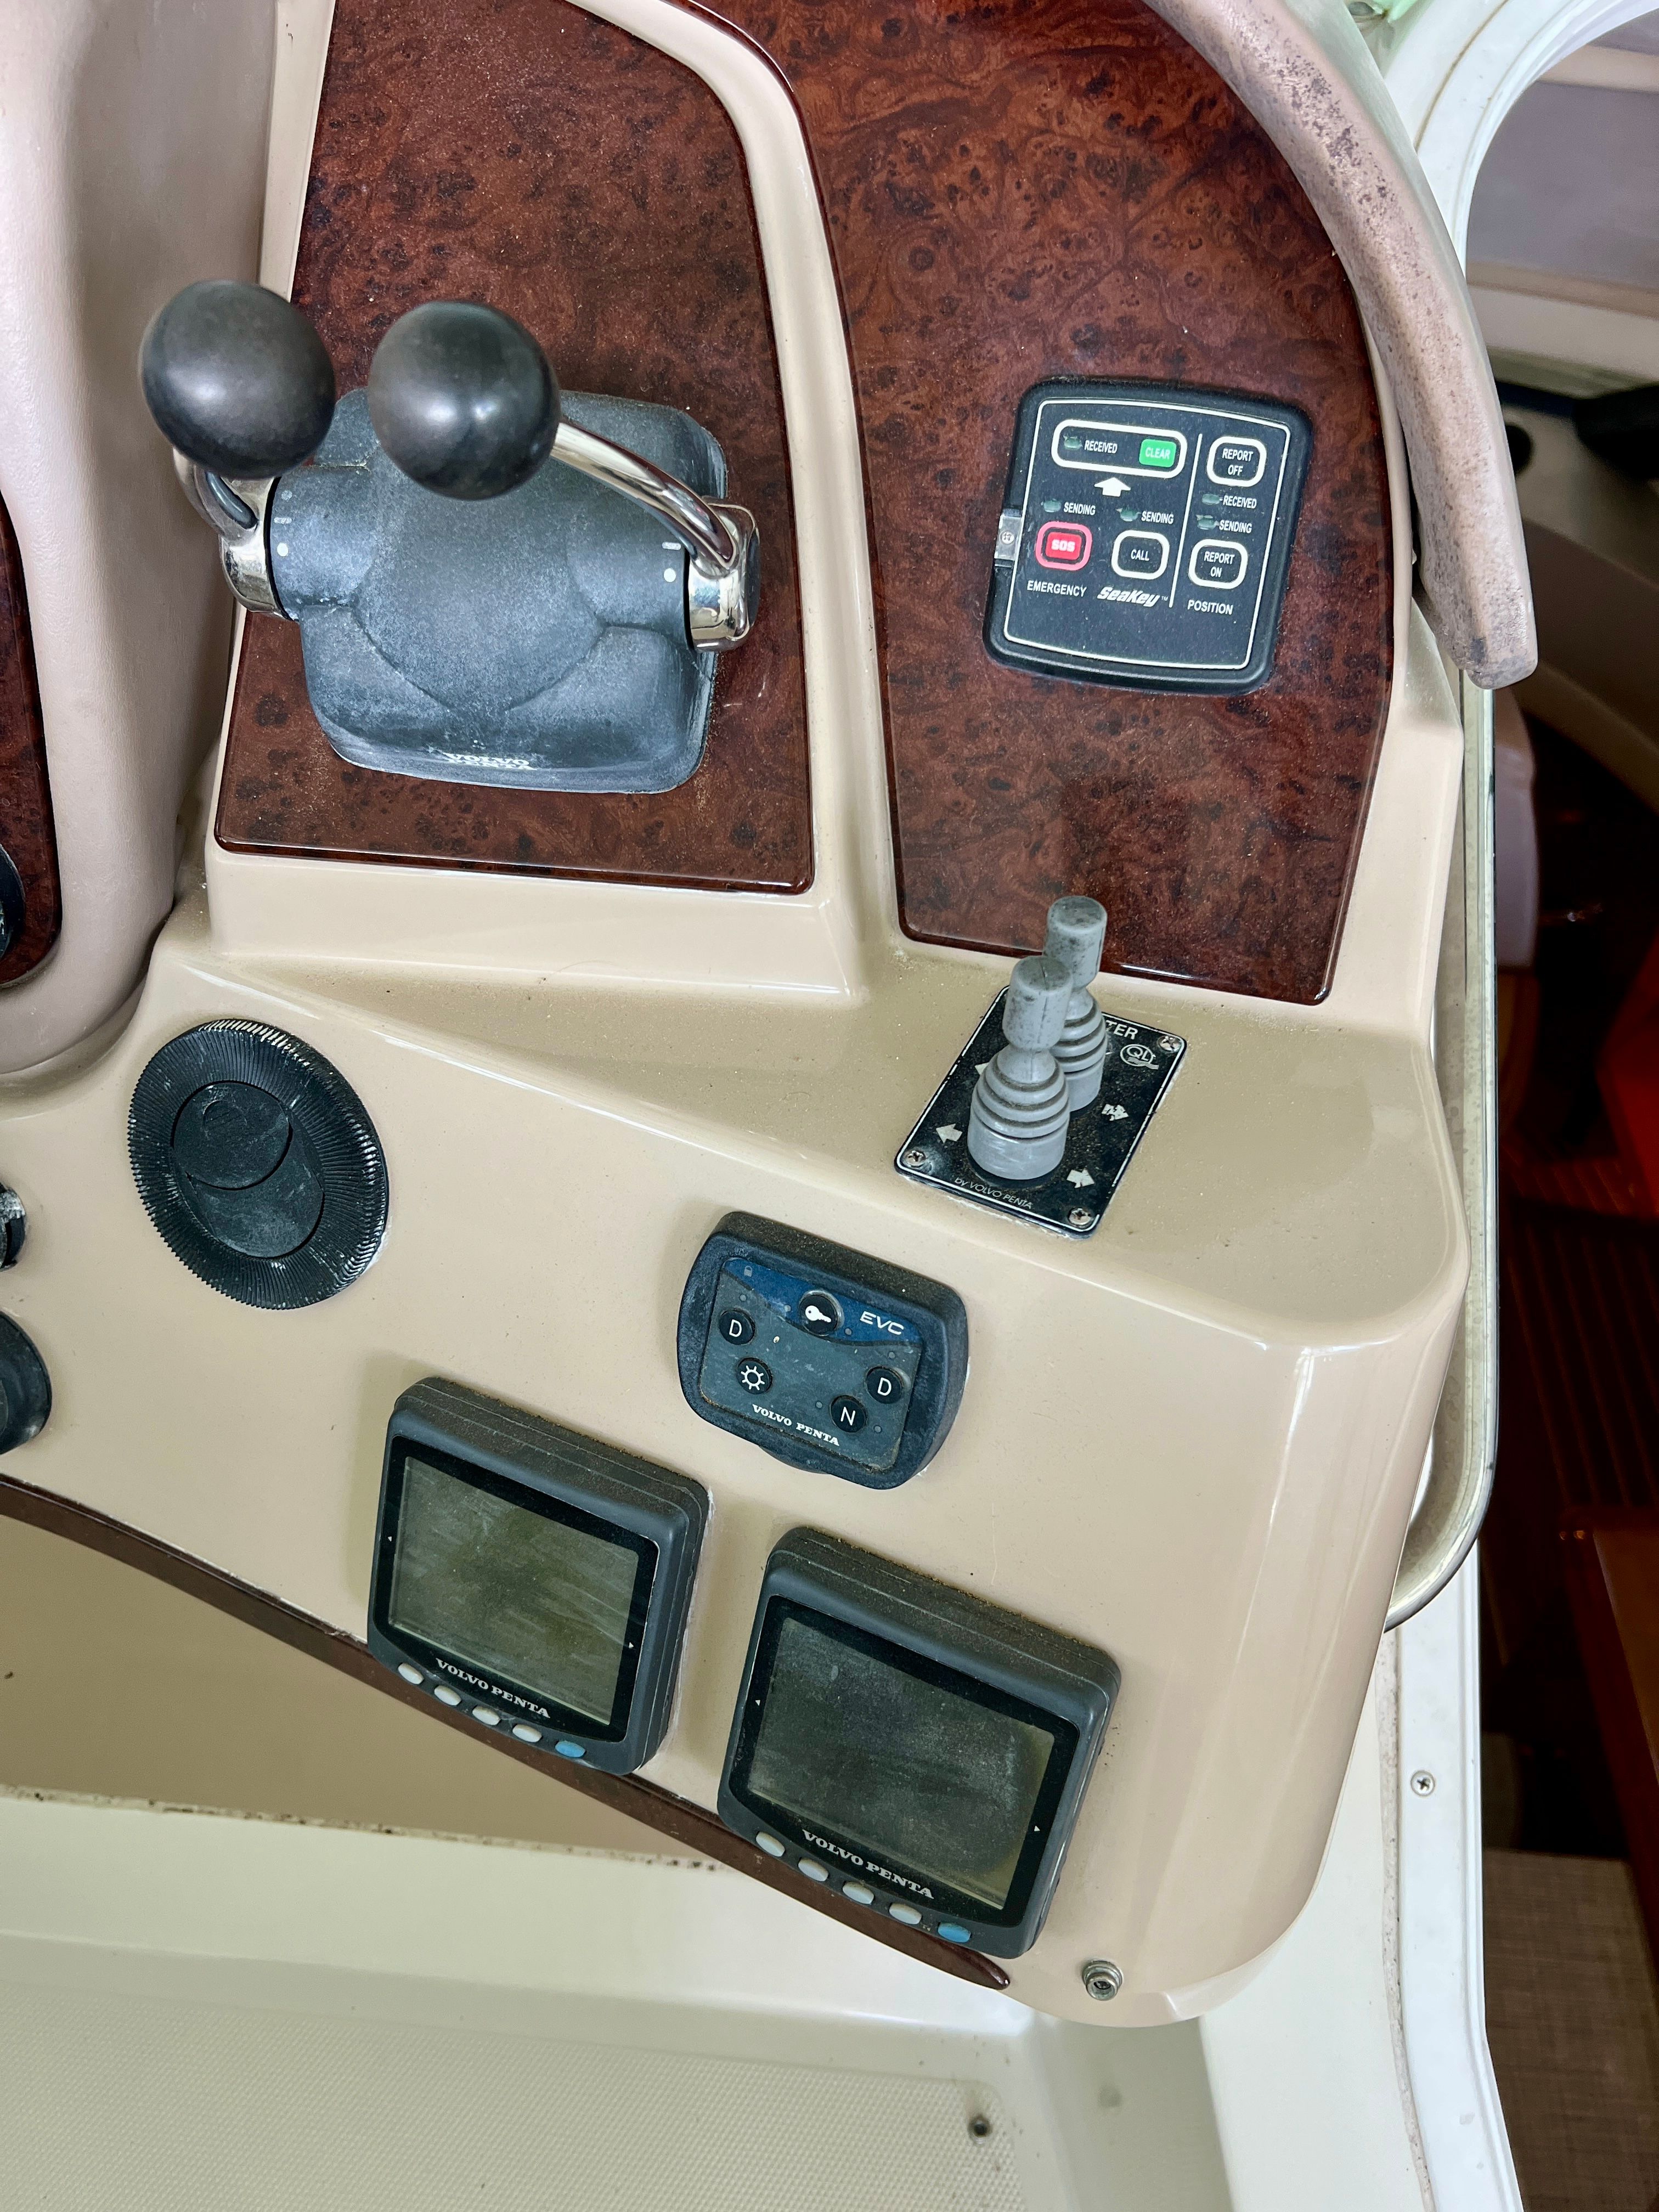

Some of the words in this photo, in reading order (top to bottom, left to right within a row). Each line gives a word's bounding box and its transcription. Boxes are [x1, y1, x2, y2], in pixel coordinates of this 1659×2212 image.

[1084, 440, 1118, 454] RECEIVED
[1145, 447, 1170, 460] CLEAR
[1222, 448, 1253, 461] REPORT
[1228, 465, 1243, 476] OFF
[1063, 501, 1096, 516] SENDING
[1223, 495, 1257, 509] RECEIVED
[1141, 511, 1174, 524] SENDING
[1219, 520, 1252, 534] SENDING
[1051, 539, 1076, 552] SOS
[1130, 550, 1150, 562] CALL
[1204, 552, 1234, 565] REPORT
[1210, 567, 1222, 578] ON
[1027, 580, 1087, 597] EMERGENCY
[1187, 600, 1233, 615] POSITION
[954, 1177, 969, 1187] by
[970, 1181, 1002, 1198] VOLVO
[729, 1318, 743, 1338] D
[860, 1311, 904, 1335] EVC
[877, 1376, 892, 1396] D
[840, 1406, 857, 1426] N
[752, 1404, 792, 1426] VOLVO
[795, 1422, 840, 1447] PENTA
[436, 1657, 489, 1690] VOLVO
[491, 1685, 550, 1718] PENTA
[802, 1829, 864, 1865] VOLVO
[865, 1861, 934, 1899] PENTA
